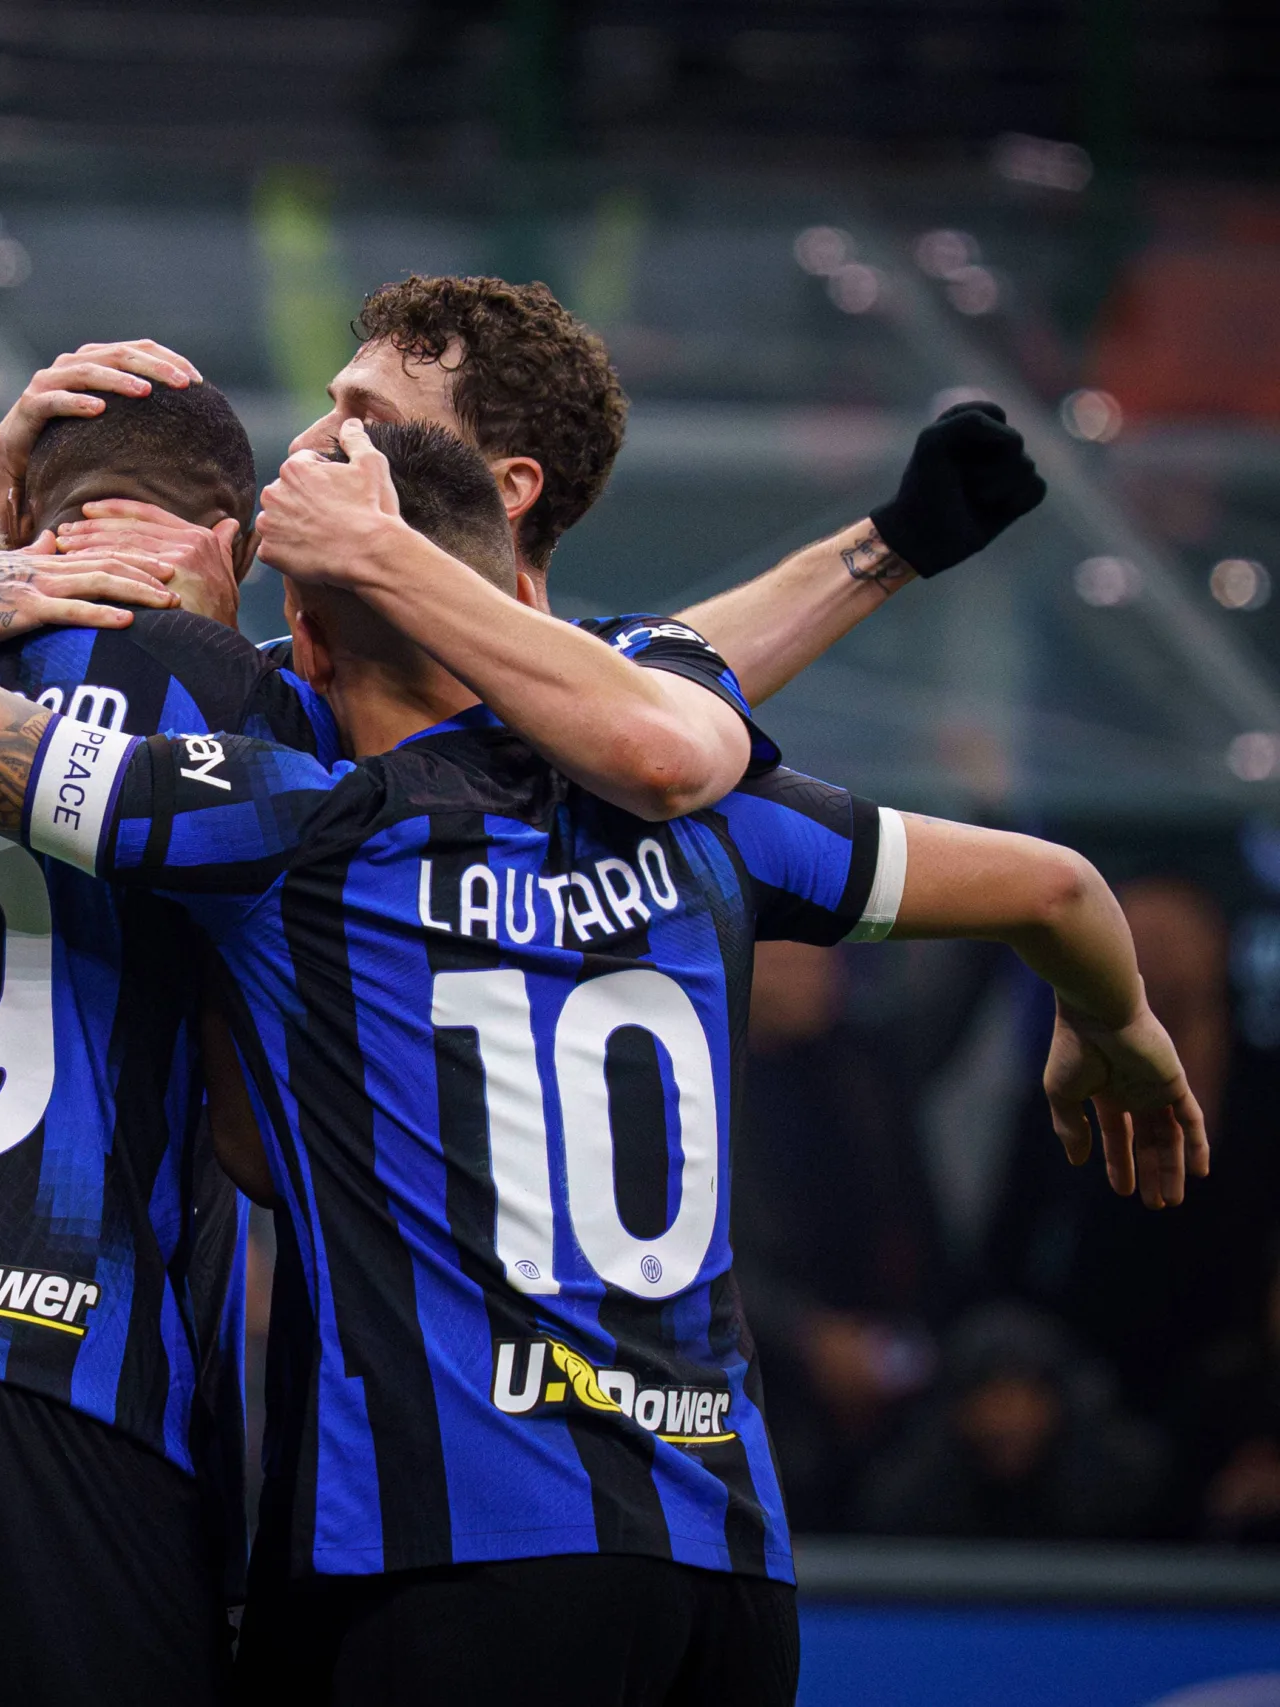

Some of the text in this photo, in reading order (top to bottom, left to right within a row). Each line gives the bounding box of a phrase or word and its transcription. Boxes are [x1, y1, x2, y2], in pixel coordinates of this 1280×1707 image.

[53, 729, 106, 831] PEACE
[420, 838, 679, 948] LAUTARO
[431, 968, 719, 1300] 10
